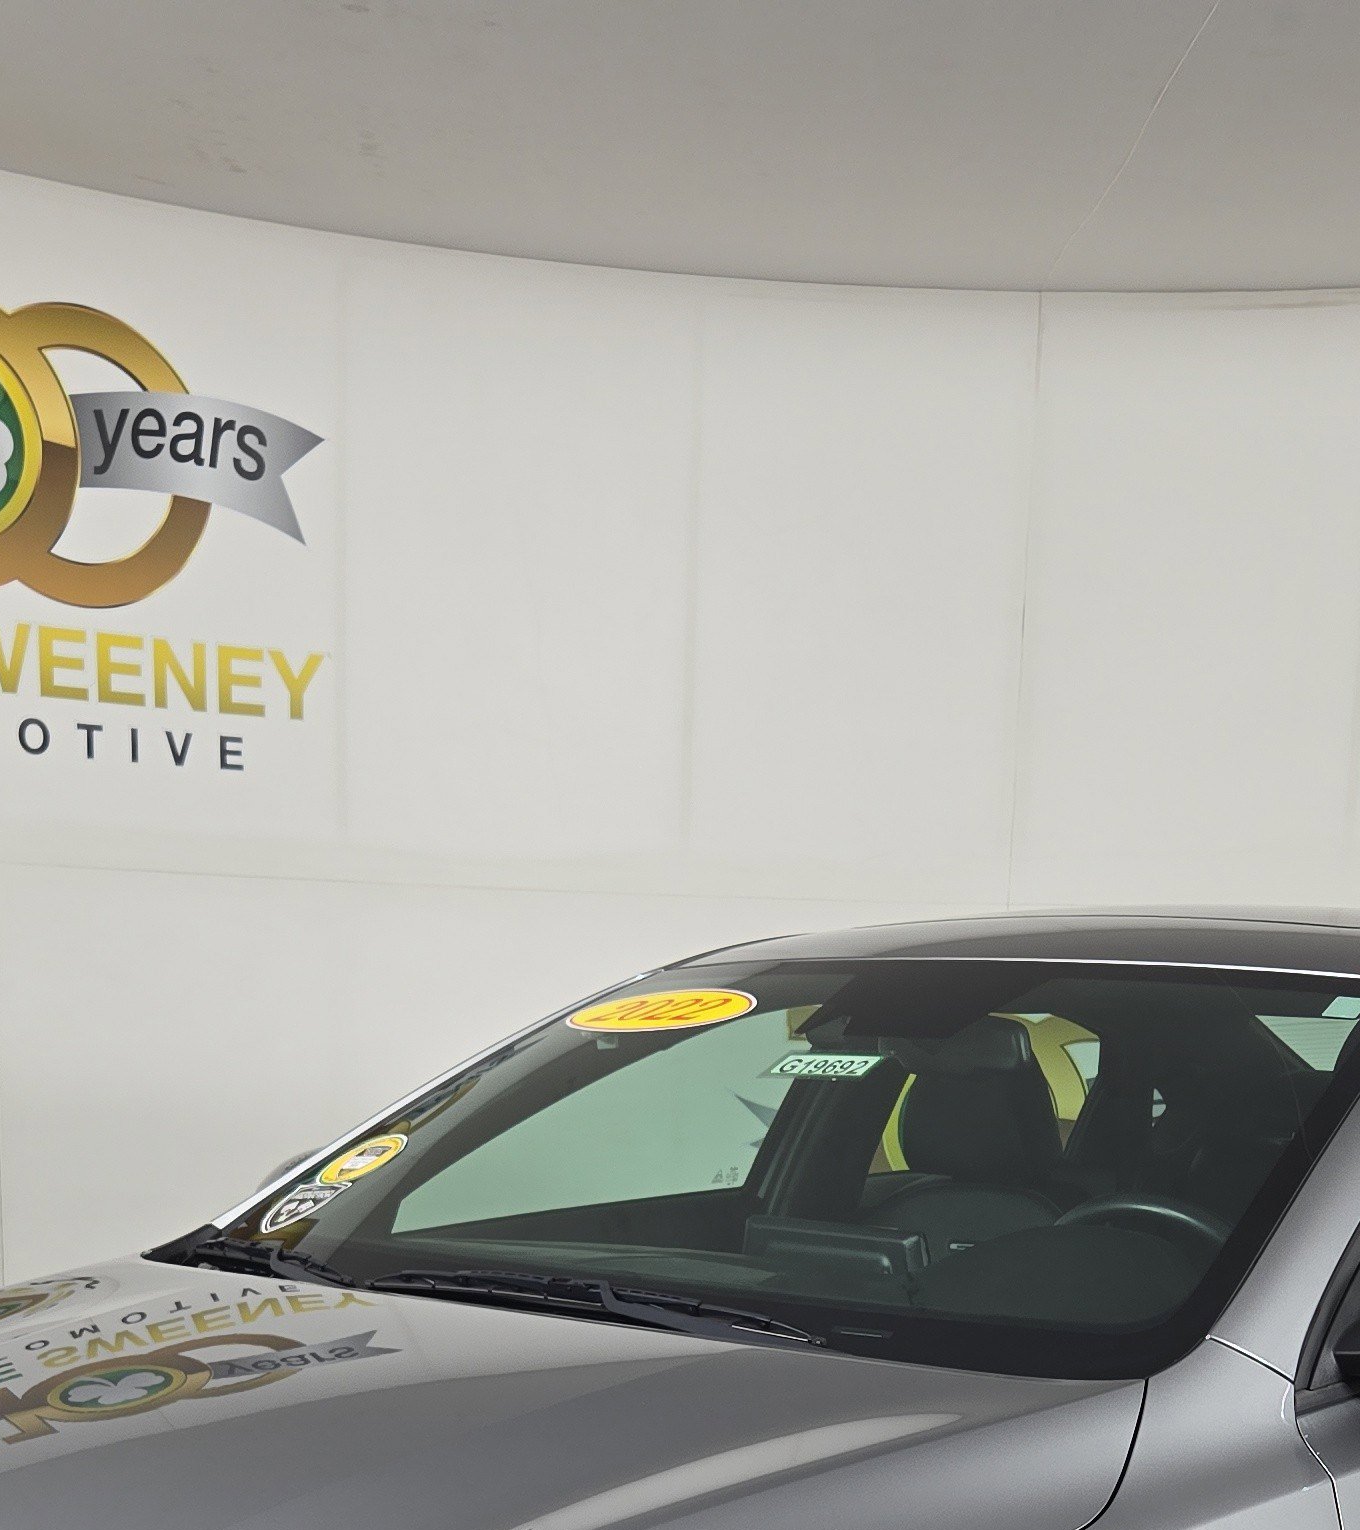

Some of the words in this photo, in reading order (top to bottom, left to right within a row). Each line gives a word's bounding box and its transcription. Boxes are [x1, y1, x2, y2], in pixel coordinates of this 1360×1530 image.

[92, 407, 269, 482] years
[585, 998, 733, 1022] 2022
[779, 1058, 869, 1075] G19692
